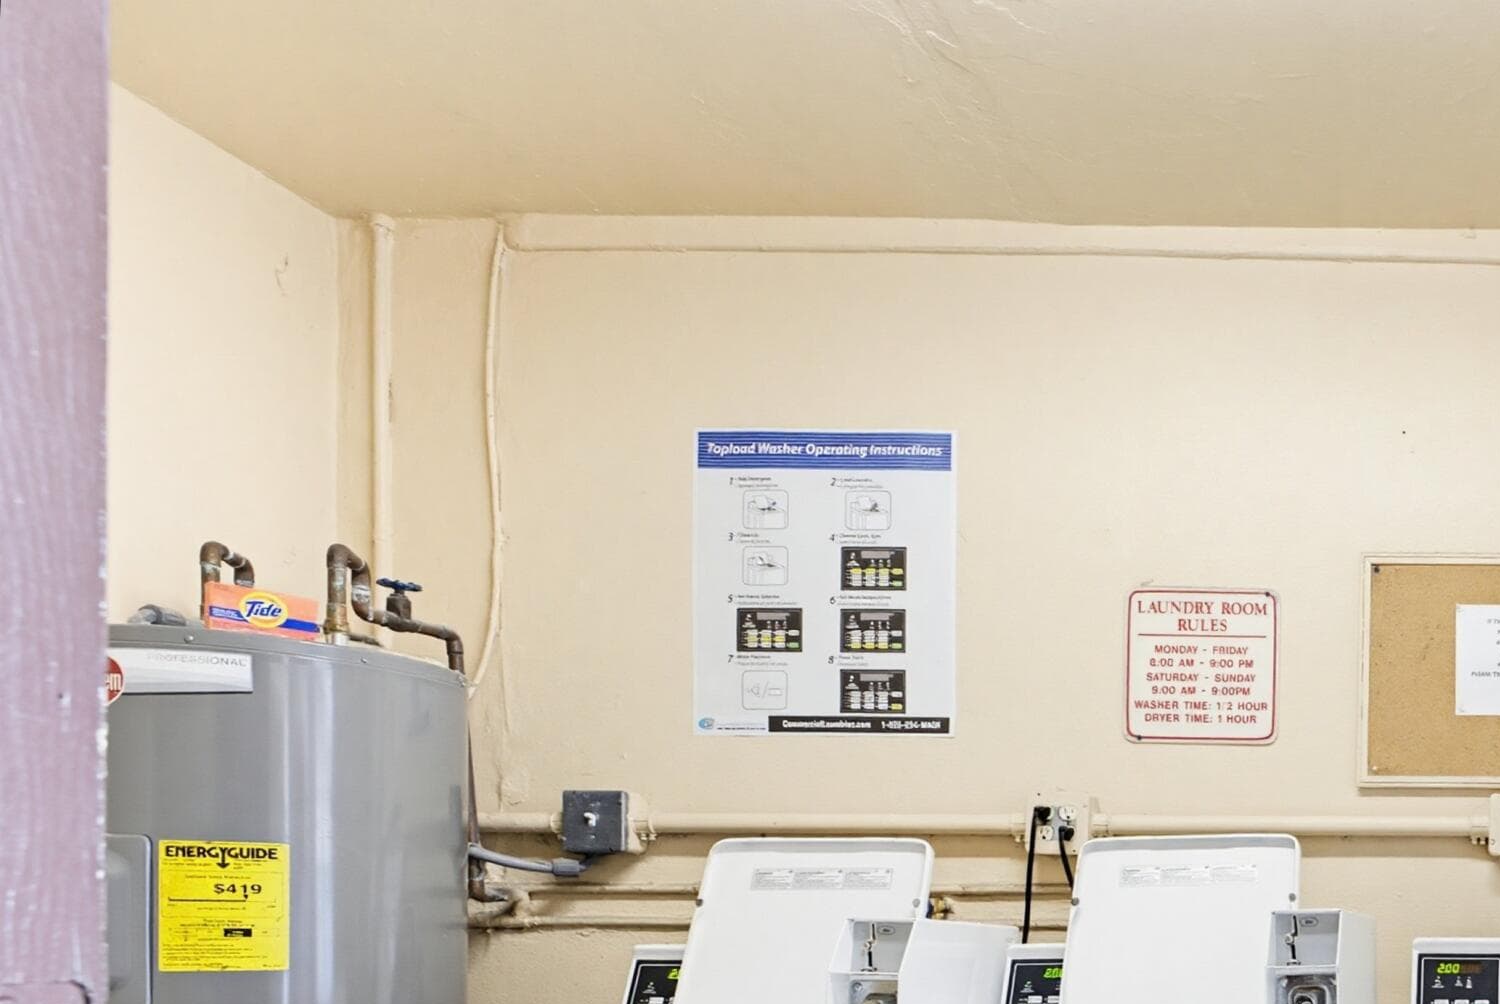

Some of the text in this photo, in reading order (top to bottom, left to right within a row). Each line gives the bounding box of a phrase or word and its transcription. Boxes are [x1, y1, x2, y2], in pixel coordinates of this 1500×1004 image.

[708, 442, 943, 458] Topload Washer Operating Instructions
[245, 600, 283, 618] Tide
[1138, 601, 1268, 616] LAUNDRY ROOM
[1178, 618, 1228, 632] RULES
[1154, 645, 1198, 655] MONDAY
[1212, 645, 1249, 655] FRIDAY
[1178, 658, 1195, 668] AM
[1238, 659, 1254, 669] PM
[1146, 672, 1200, 682] SATURDAY
[1214, 673, 1256, 683] SUNDAY
[1180, 686, 1197, 695] AM
[1134, 700, 1179, 710] WASHER
[1183, 701, 1212, 711] TIME:
[1237, 701, 1268, 711] HOUR
[1144, 713, 1180, 723] DRYER
[1185, 714, 1213, 723] TIME:
[1226, 714, 1257, 724] HOUR
[165, 845, 279, 862] ENERGYGUIDE
